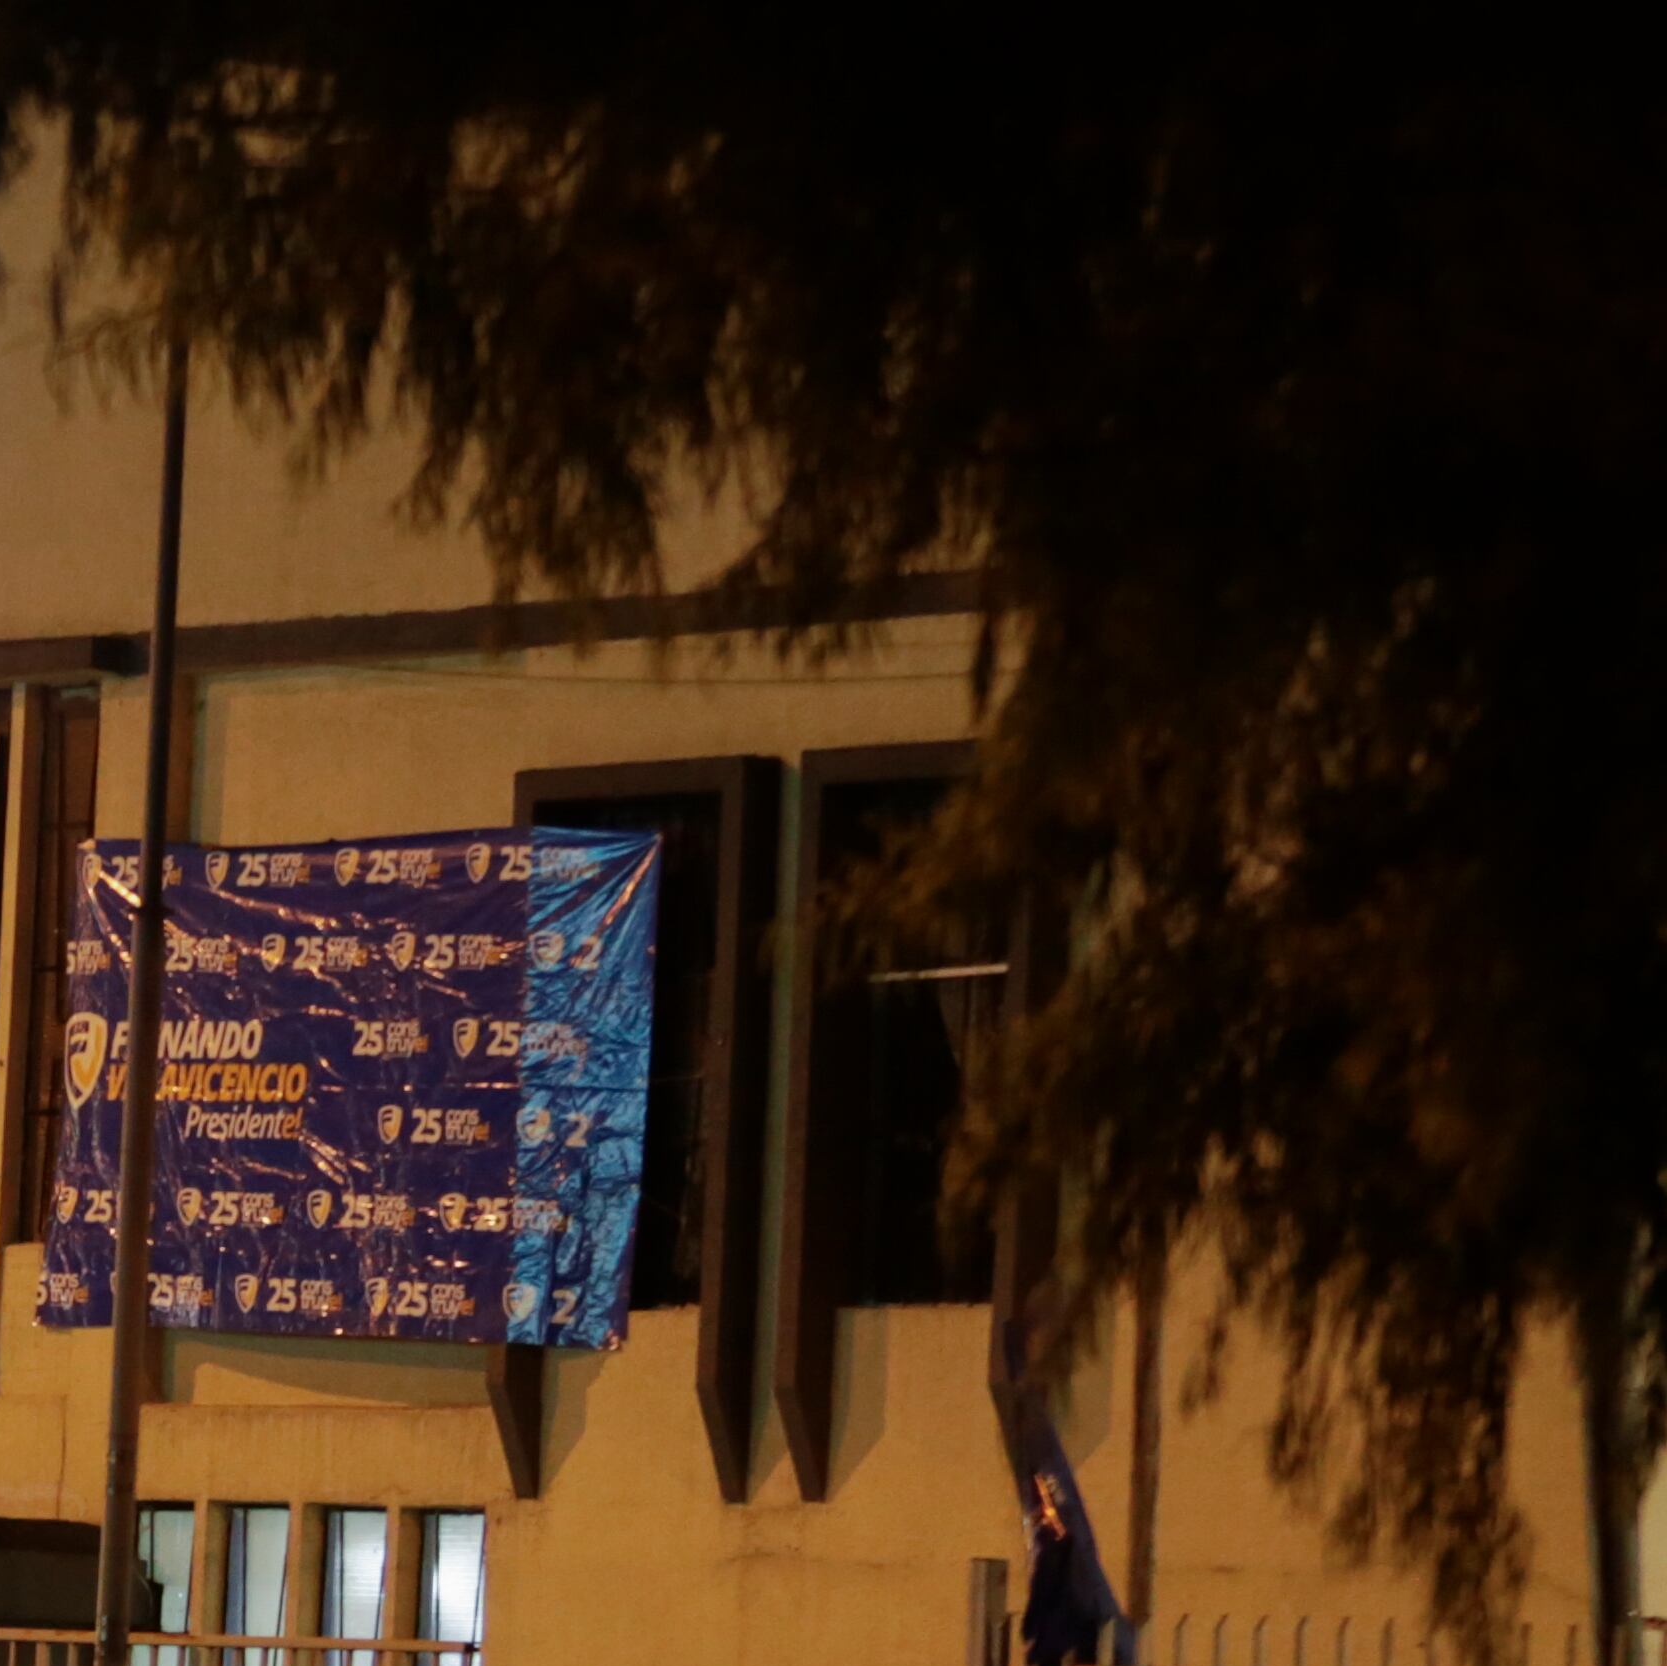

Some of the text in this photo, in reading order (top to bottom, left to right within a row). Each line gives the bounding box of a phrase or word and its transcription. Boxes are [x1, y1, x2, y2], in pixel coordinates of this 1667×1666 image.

[110, 856, 139, 888] 25
[236, 854, 268, 887] 25
[365, 851, 397, 883] 25
[500, 846, 532, 881] 25
[292, 937, 325, 971] 25
[423, 935, 456, 969] 25
[110, 1019, 264, 1060] FNANDO
[352, 1021, 384, 1056] 25
[486, 1021, 521, 1056] 25
[107, 1063, 307, 1101] VAVICENCIO
[410, 1109, 443, 1144] 25
[85, 1190, 113, 1222] 25
[209, 1191, 239, 1225] 25
[341, 1195, 371, 1227] 25
[147, 1273, 174, 1307] 25
[267, 1278, 298, 1311] 25
[395, 1283, 427, 1316] 25
